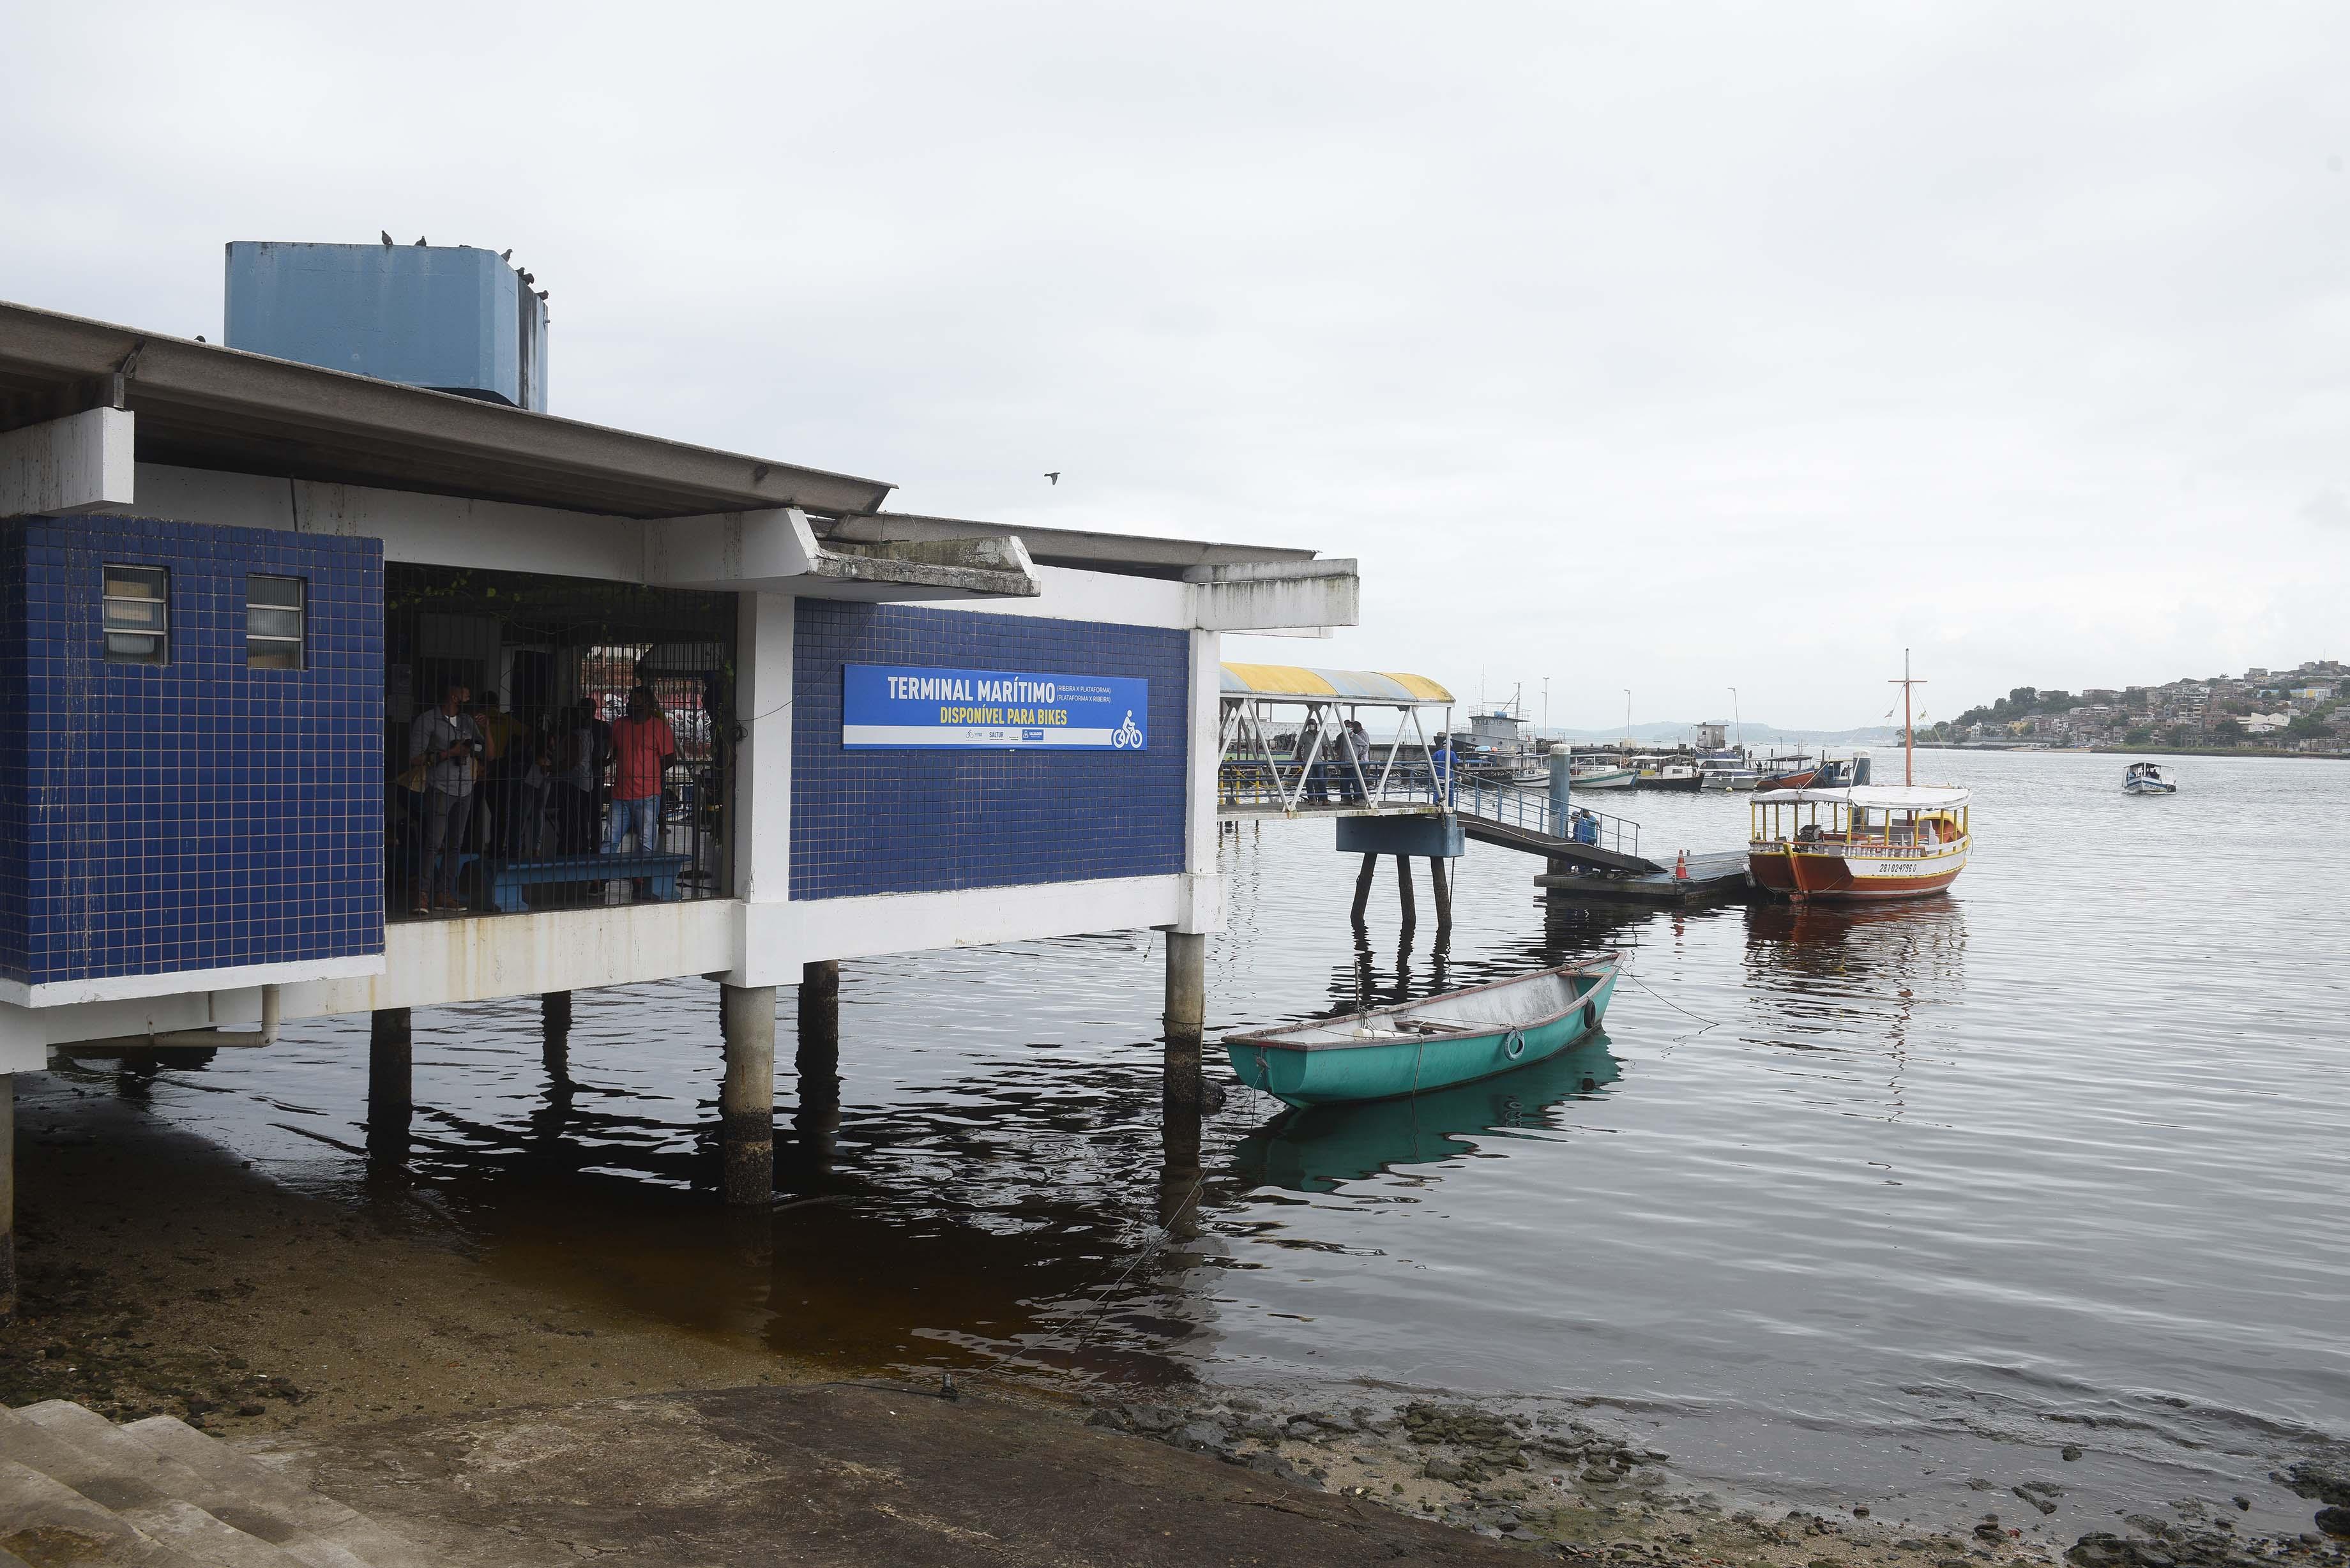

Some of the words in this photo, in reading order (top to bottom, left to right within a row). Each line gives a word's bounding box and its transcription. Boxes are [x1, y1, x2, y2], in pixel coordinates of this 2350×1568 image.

[888, 676, 973, 702] TERMINAL
[978, 676, 1055, 704] MARÍTIMO
[1080, 686, 1111, 695] PLATAFORMA)
[940, 704, 1004, 724] DISPONÍVEL
[1007, 708, 1035, 725] PARA
[1037, 709, 1067, 725] BIKES
